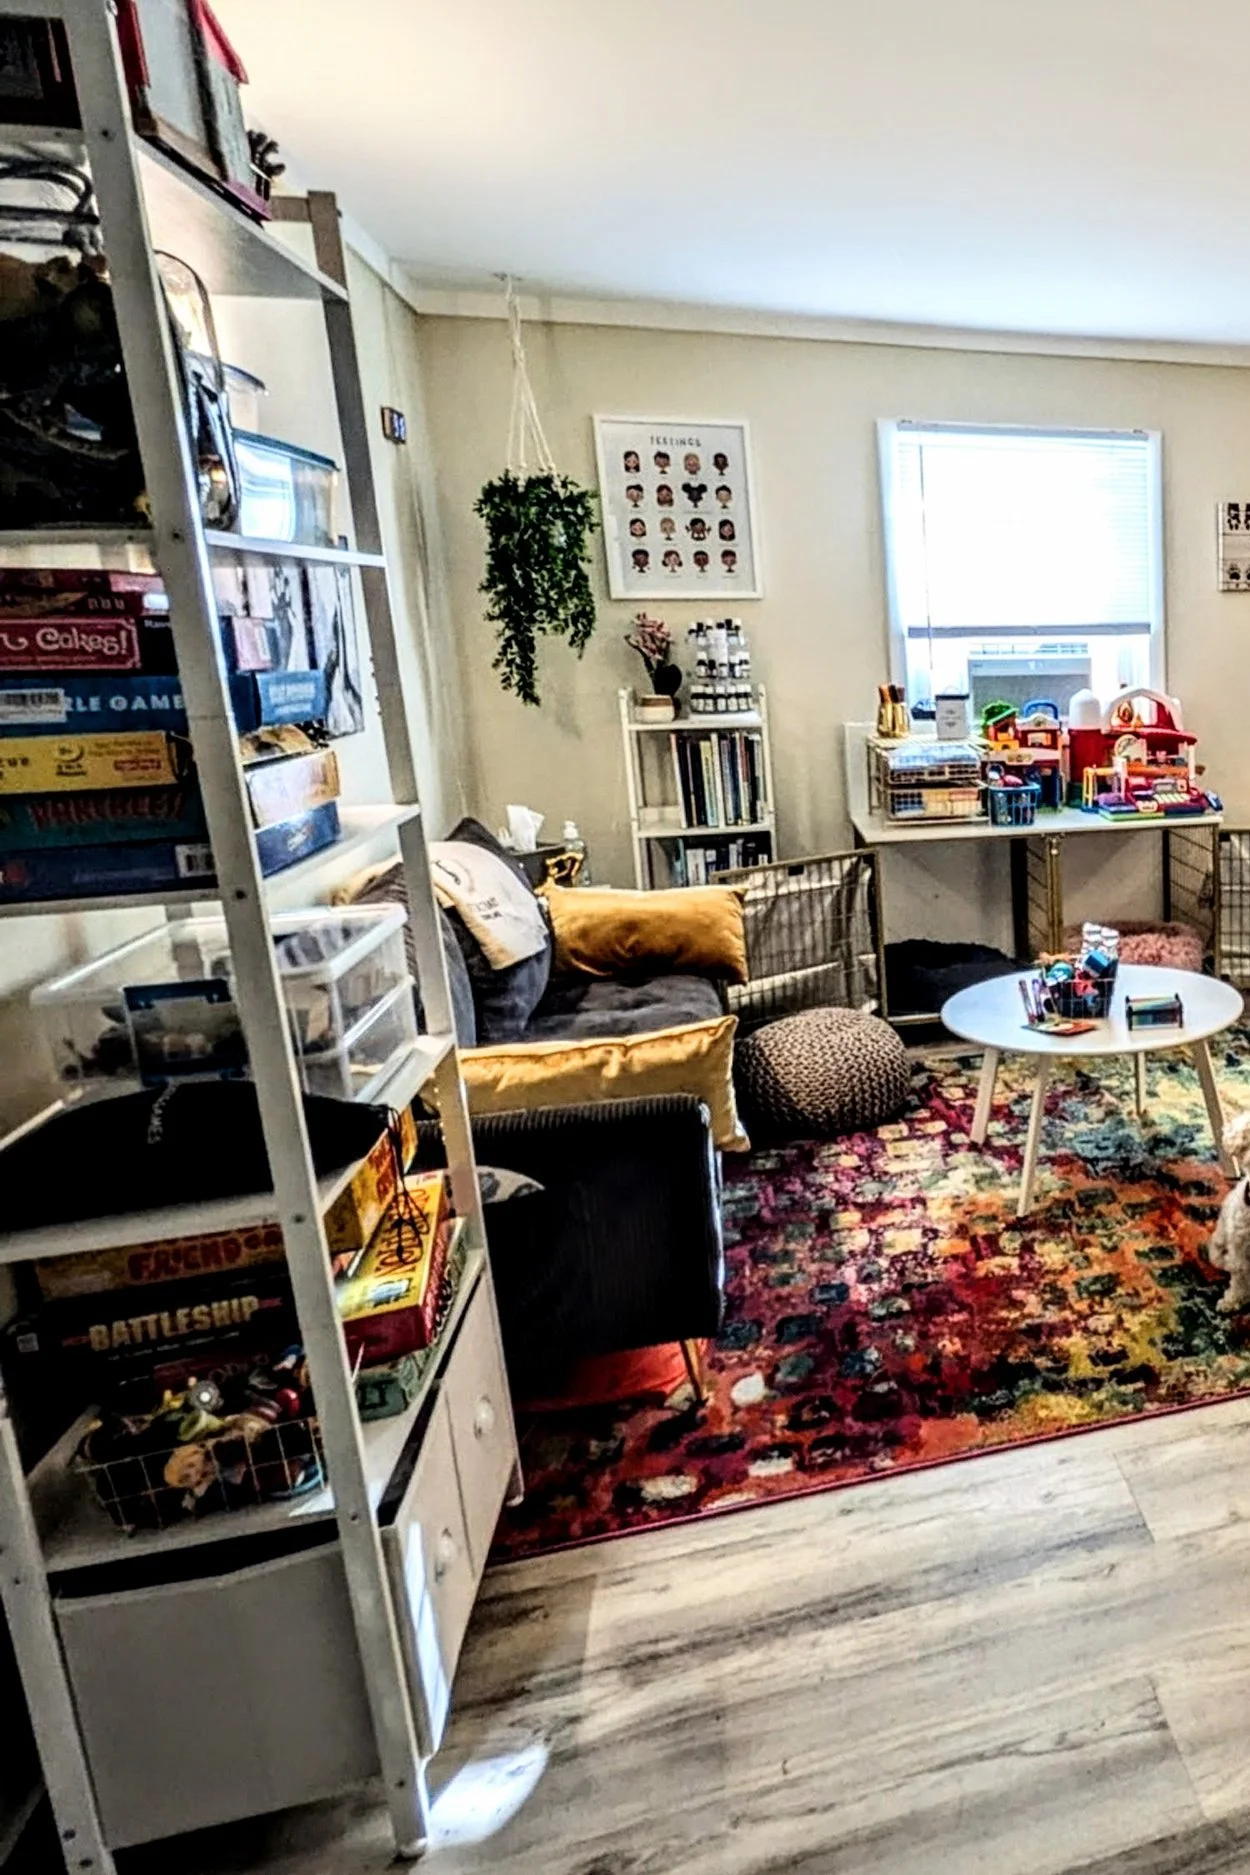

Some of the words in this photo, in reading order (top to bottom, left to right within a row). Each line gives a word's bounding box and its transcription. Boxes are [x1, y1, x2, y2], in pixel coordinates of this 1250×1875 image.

[35, 627, 128, 656] Cakes!
[127, 1236, 243, 1281] FRIEND
[88, 1295, 260, 1351] BATTLESHIP
